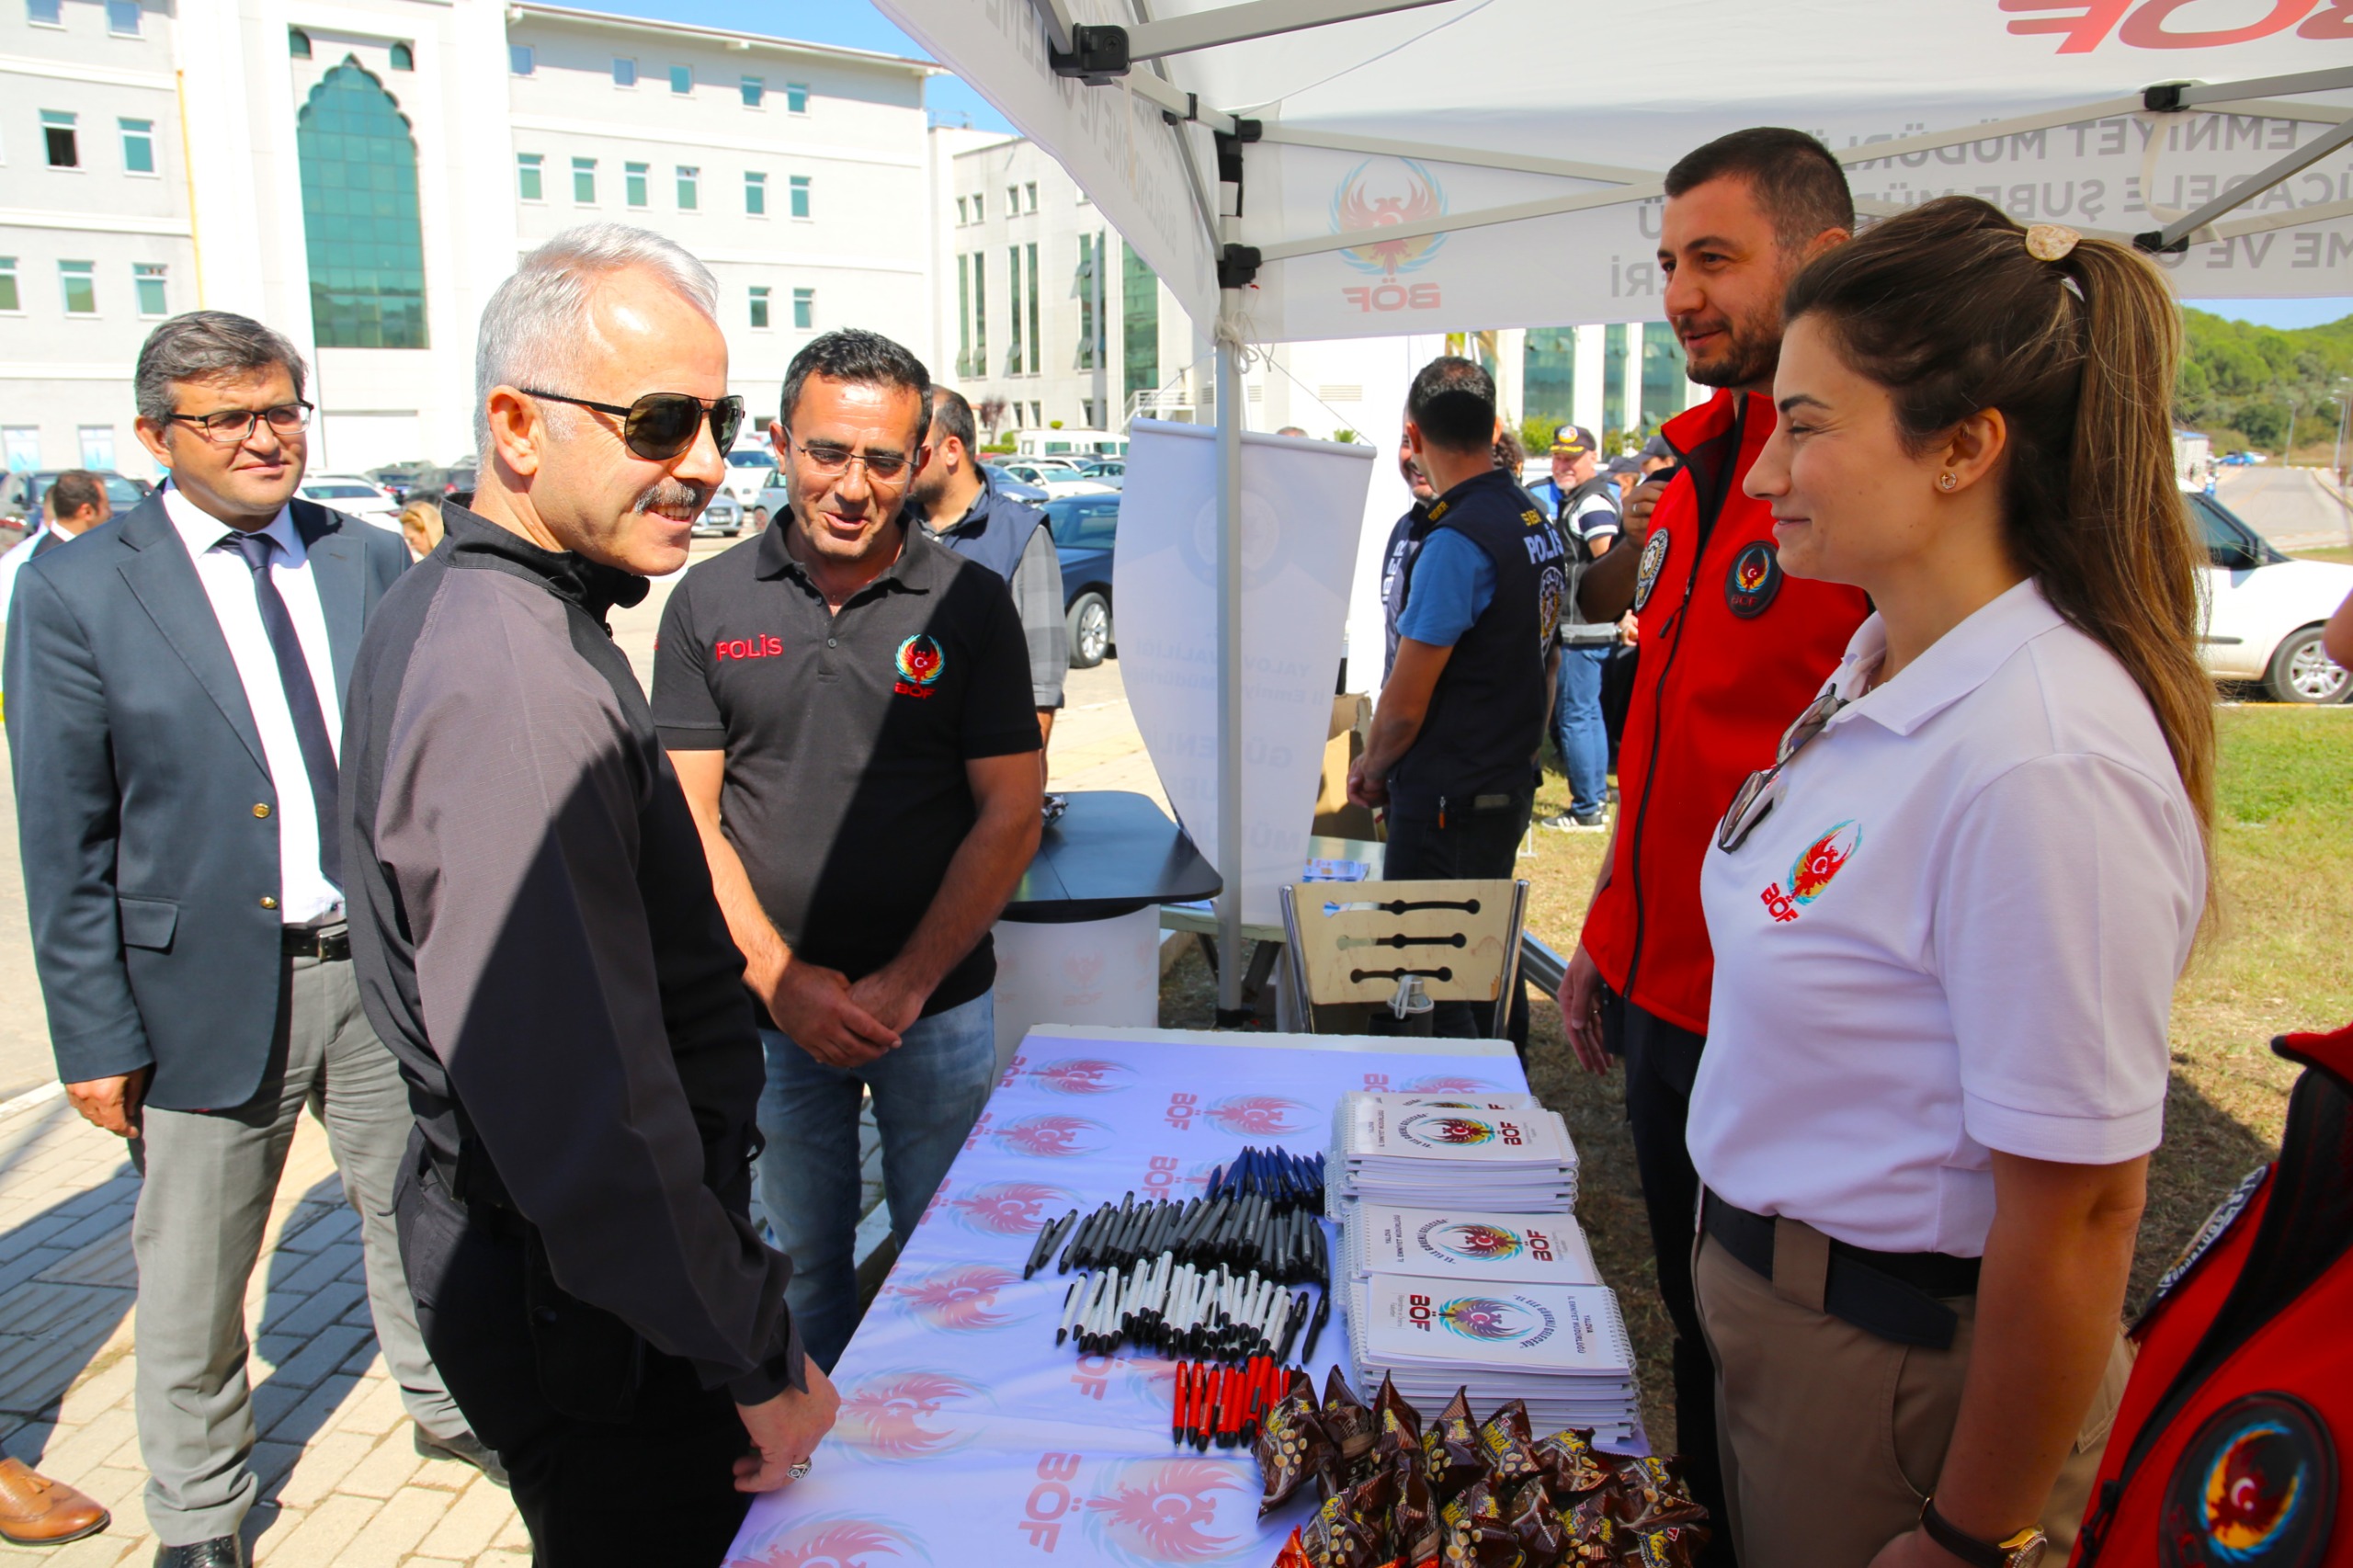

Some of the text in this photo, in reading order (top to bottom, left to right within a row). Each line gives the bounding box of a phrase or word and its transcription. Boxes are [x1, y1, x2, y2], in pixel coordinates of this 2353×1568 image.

[1523, 523, 1564, 564] POLİS
[715, 632, 784, 663] POLİS
[893, 681, 937, 699] BÖF
[1760, 882, 1800, 923] BÖF
[1164, 1092, 1202, 1131] BÖF
[1497, 1121, 1522, 1145] BÖF
[1141, 1155, 1183, 1200] BÖF
[1524, 1229, 1553, 1262] BÖF
[1409, 1294, 1437, 1333] BÖF
[1070, 1352, 1125, 1401] ÖF
[1017, 1452, 1083, 1553] BÖF
